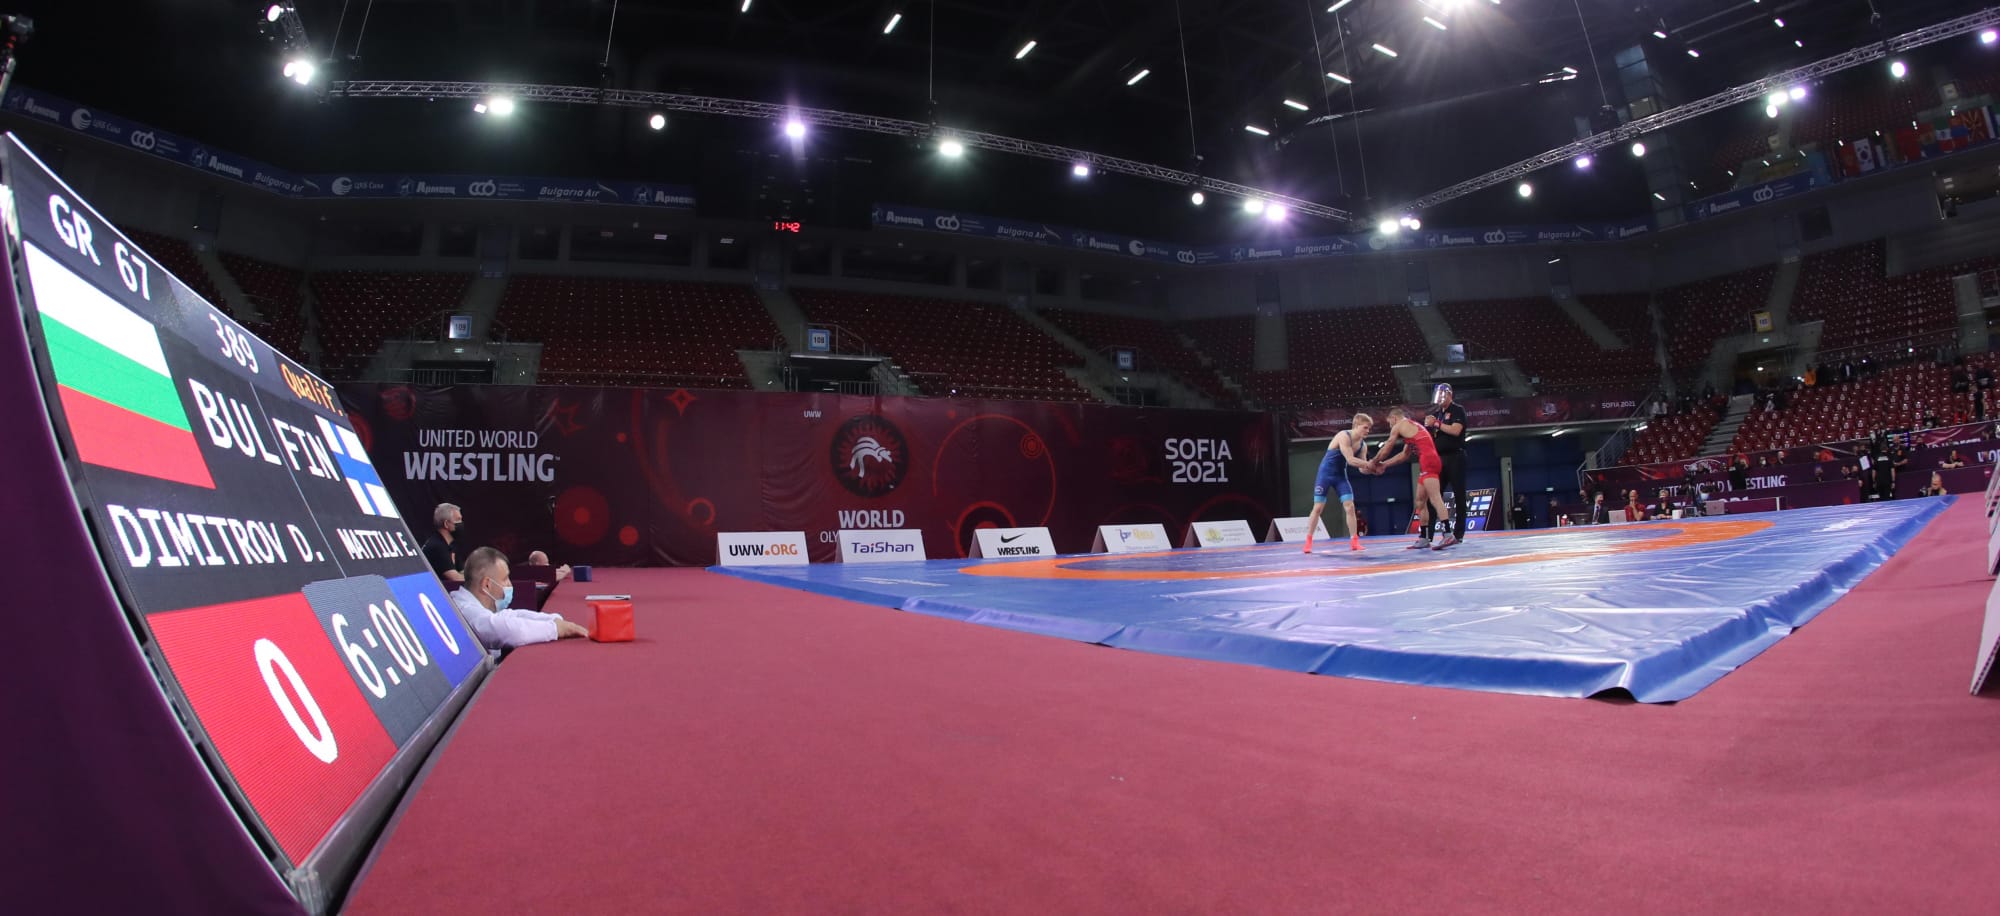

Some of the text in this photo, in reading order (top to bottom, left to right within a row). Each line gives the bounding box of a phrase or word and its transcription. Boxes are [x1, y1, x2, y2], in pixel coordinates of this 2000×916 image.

[539, 186, 600, 198] Bulgaria Air
[49, 194, 101, 266] GR
[114, 241, 150, 301] 67
[208, 313, 260, 374] 389
[279, 363, 344, 416] Qualif.
[188, 378, 282, 466] BUL
[803, 410, 821, 418] UWW
[272, 418, 340, 481] FIN
[419, 429, 538, 449] UNITED WORLD
[1165, 438, 1232, 460] SOFIA
[1172, 461, 1228, 482] 2021
[838, 509, 905, 529] WORLD
[1467, 520, 1475, 530] 0
[107, 503, 325, 568] DIMITROV D.
[337, 528, 418, 560] MATTILA E.
[729, 544, 798, 556] UWW.ORG
[851, 541, 915, 554] TaiShan
[997, 546, 1040, 555] WRESTLING
[419, 593, 460, 655] 0
[331, 599, 429, 699] 6:00
[253, 638, 338, 764] 0
